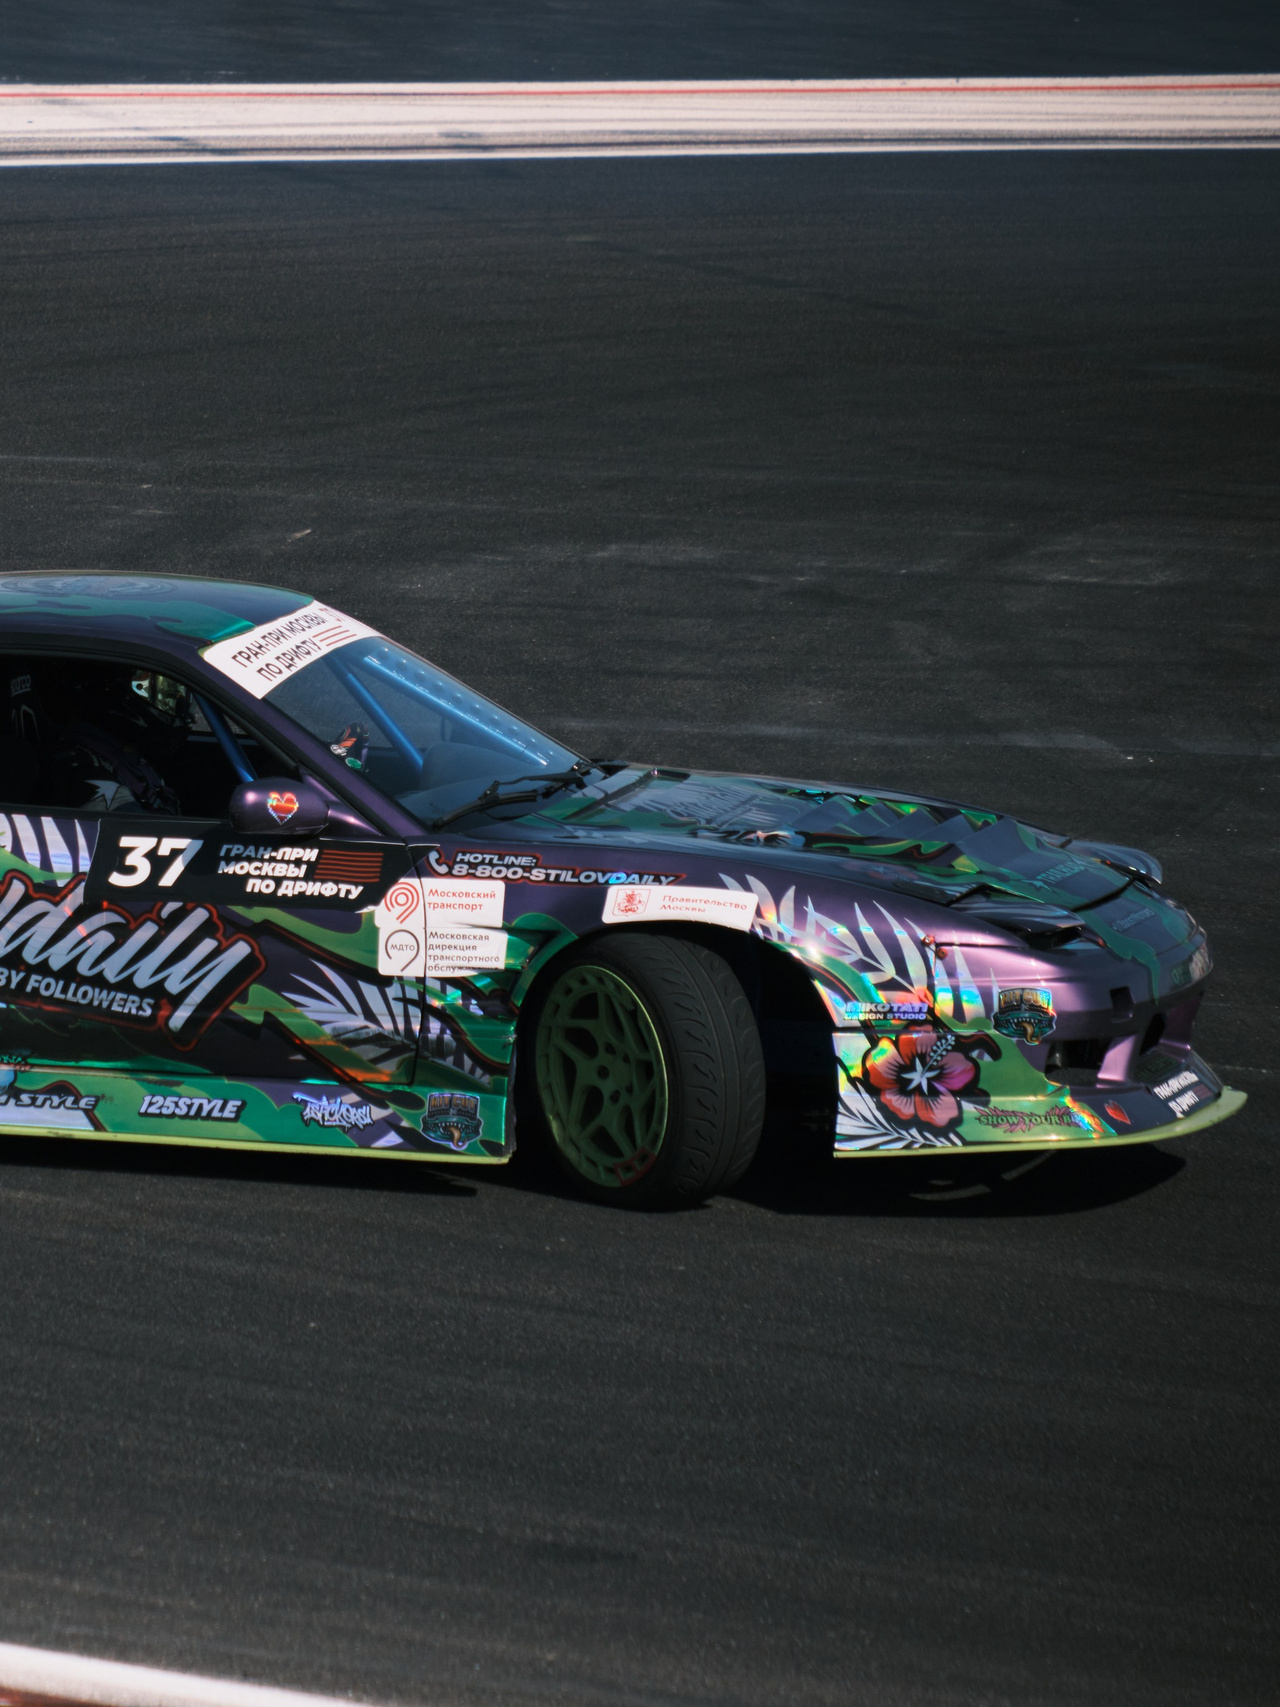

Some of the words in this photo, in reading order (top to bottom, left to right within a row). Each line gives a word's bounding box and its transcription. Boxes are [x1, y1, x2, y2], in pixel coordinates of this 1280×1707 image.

[231, 628, 292, 668] ГРАН-ПРИ
[256, 663, 284, 682] ПО
[274, 638, 322, 672] ДРИФТУ
[219, 844, 320, 862] ГРАН-ПРИ
[456, 853, 537, 866] HOTLINE:
[108, 836, 204, 887] 37
[218, 860, 308, 878] МОСКВЫ
[452, 864, 677, 886] 8-800-STILOVDAILY
[245, 879, 276, 893] ПО
[277, 880, 364, 900] ДРИФТУ
[428, 889, 496, 899] Московский
[427, 902, 483, 912] транспорт
[660, 904, 706, 913] Москвы
[662, 895, 748, 910] Правительство
[428, 931, 490, 941] Московская
[390, 944, 415, 952] МДТО
[428, 944, 477, 952] дирекция
[427, 954, 500, 963] транспортного
[26, 974, 155, 1018] FOLLOWERS
[844, 1012, 885, 1021] DESIGN
[886, 1013, 927, 1021] STUDIO
[14, 1093, 99, 1110] STYLE
[139, 1095, 242, 1119] 125STYLE
[979, 1115, 1020, 1125] SHOW
[1022, 1115, 1059, 1125] YOUR
